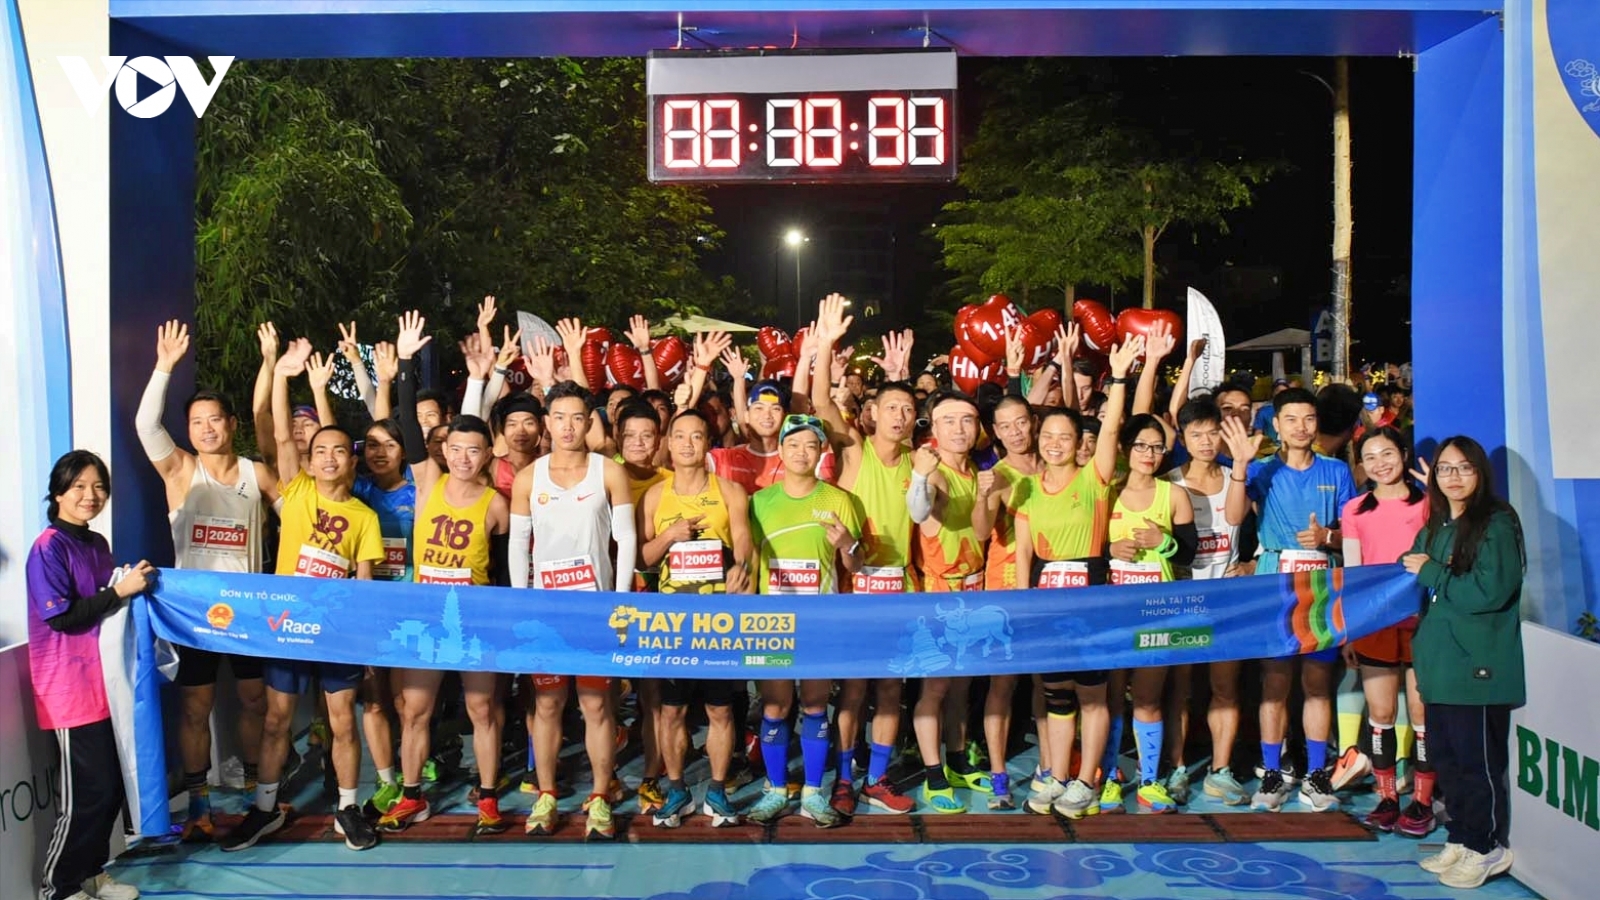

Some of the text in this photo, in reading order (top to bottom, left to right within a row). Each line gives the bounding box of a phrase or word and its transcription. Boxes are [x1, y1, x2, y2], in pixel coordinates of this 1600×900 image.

[195, 529, 245, 543] B 20261
[426, 514, 474, 550] 18
[386, 551, 404, 562] 56
[423, 548, 466, 568] RUN
[672, 553, 720, 566] A 20092
[298, 558, 344, 579] B 20167
[543, 570, 592, 586] A 20104
[770, 572, 817, 583] A 20069
[858, 575, 903, 591] B 20120
[1040, 574, 1086, 586] B 20160
[1111, 573, 1159, 584] C 20869
[638, 612, 791, 634] TAY HO 2023
[638, 636, 795, 650] HALF MARATHON
[612, 653, 660, 666] legend
[665, 656, 699, 666] race
[730, 659, 738, 667] by
[1516, 723, 1600, 831] BIM
